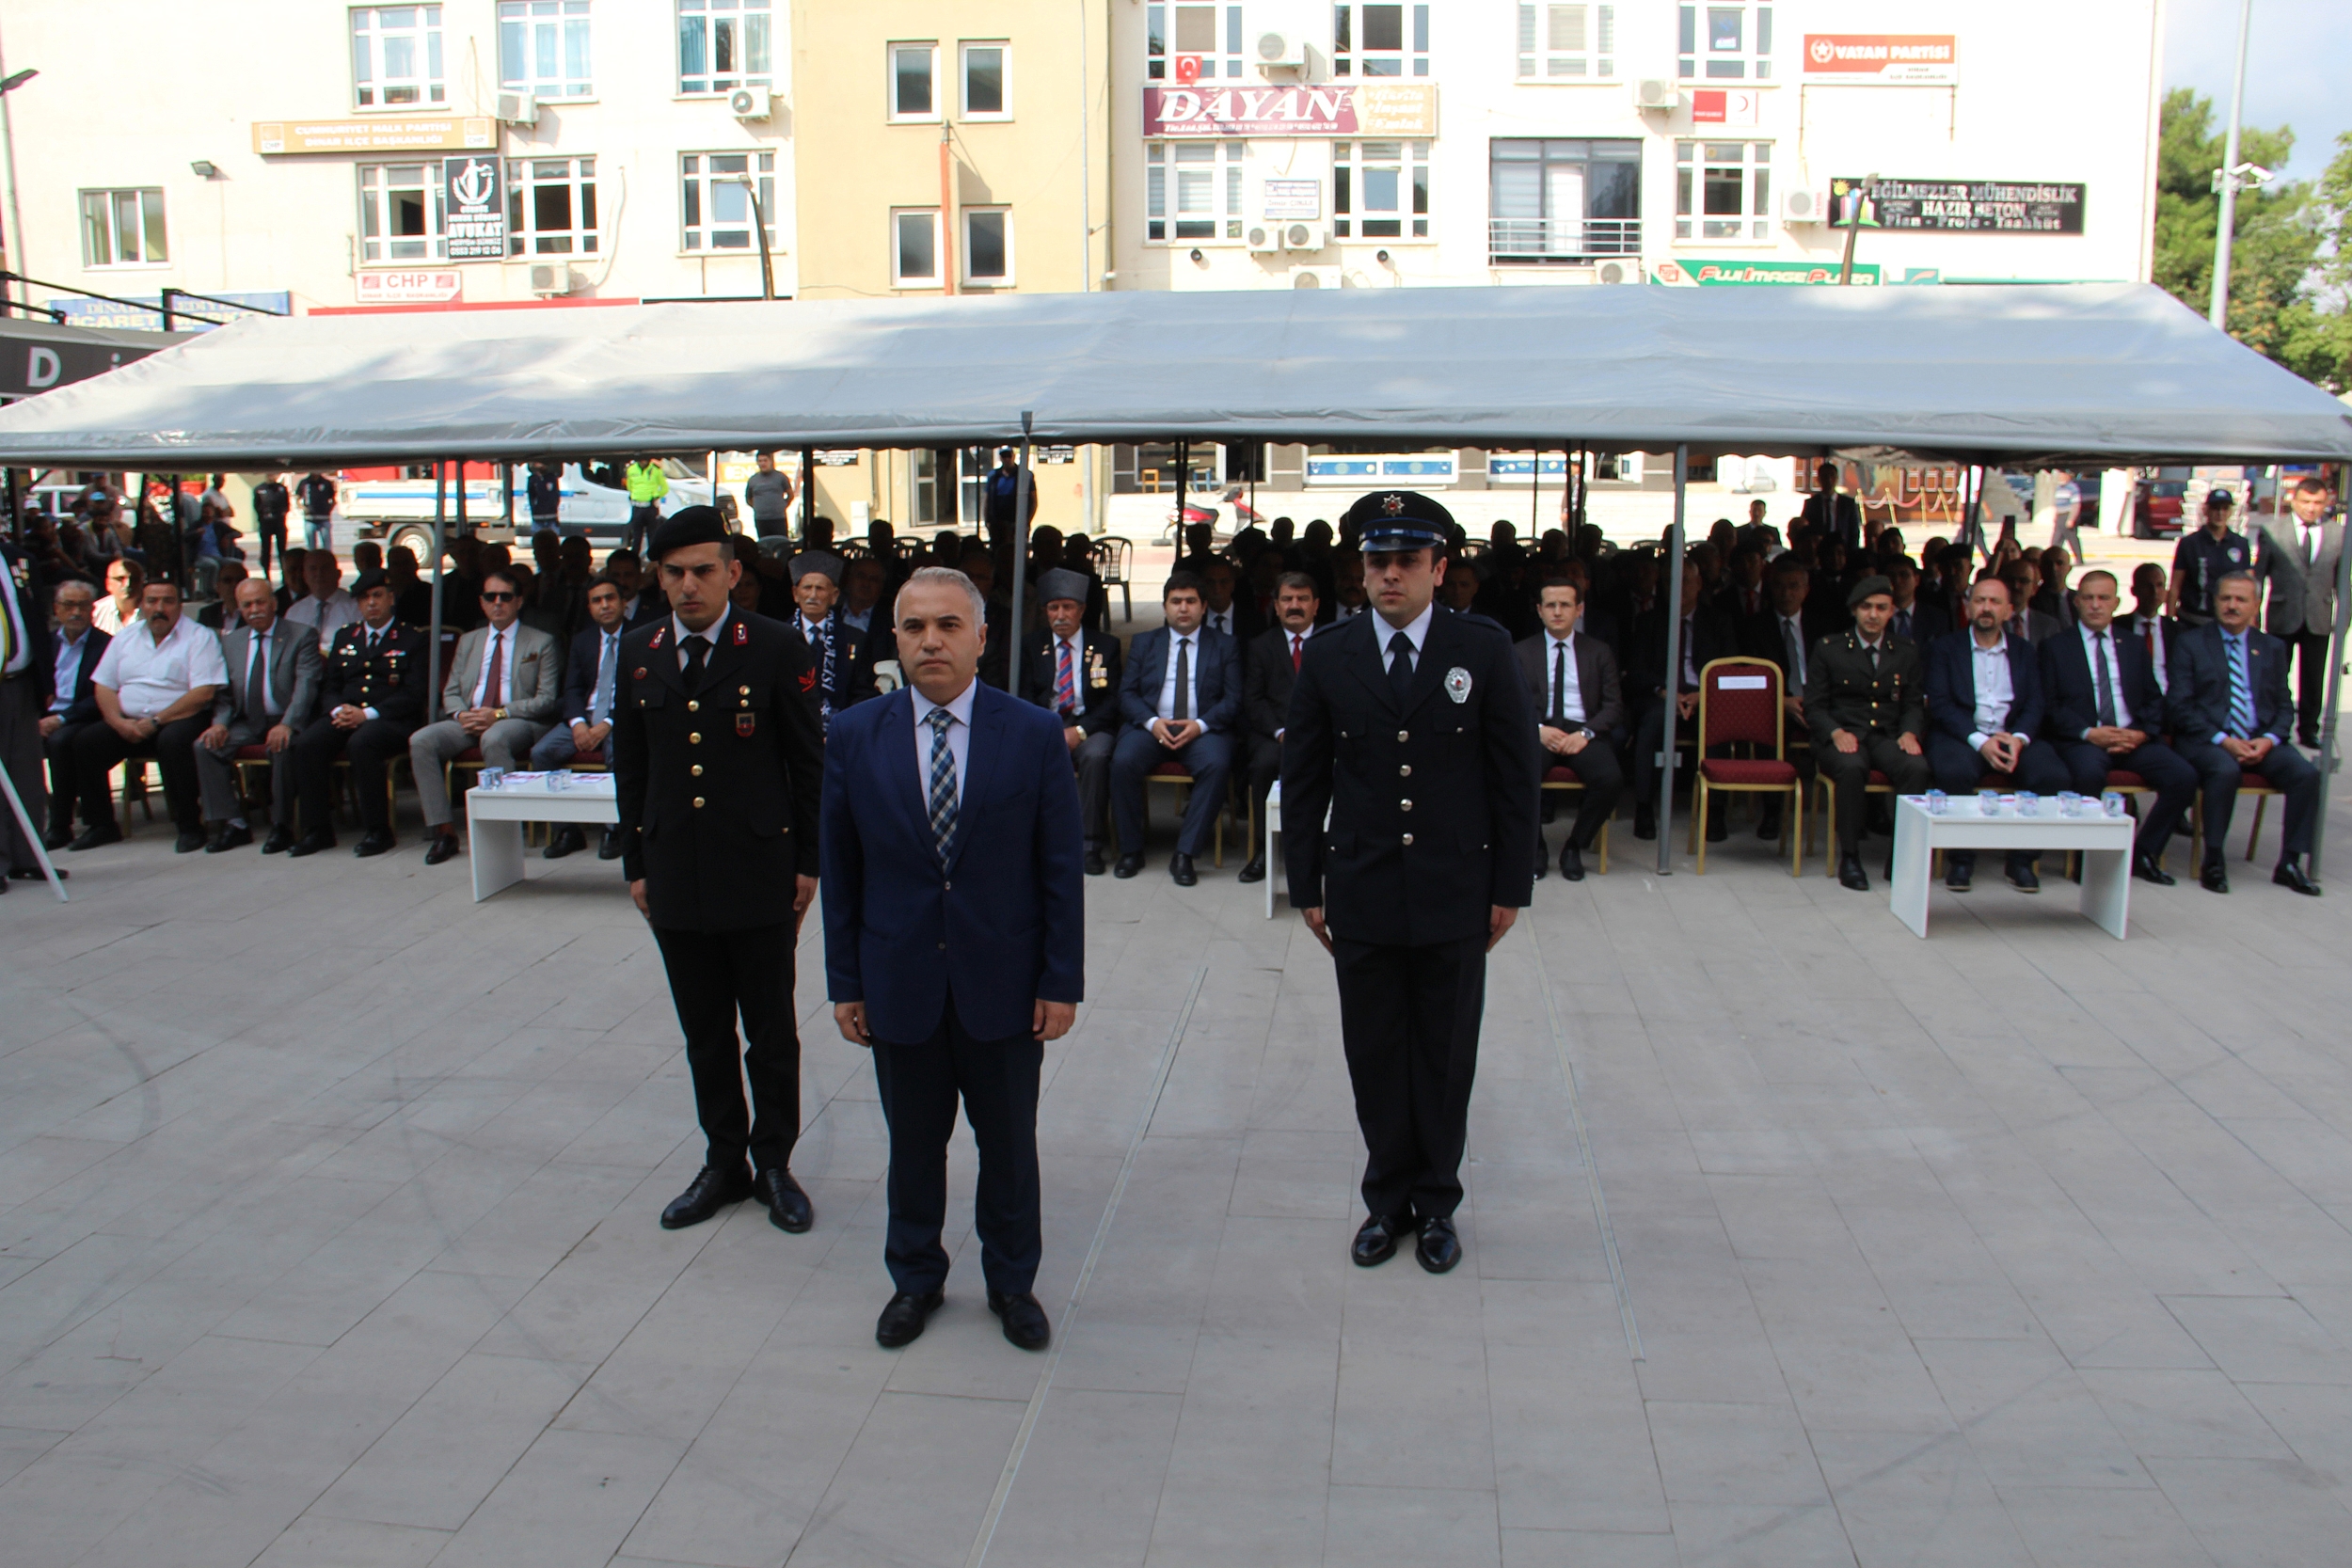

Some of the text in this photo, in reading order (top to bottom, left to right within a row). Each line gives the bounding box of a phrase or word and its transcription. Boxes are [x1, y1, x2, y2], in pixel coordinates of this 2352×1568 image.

[1835, 45, 1887, 59] VATAN
[1155, 89, 1348, 122] DAYAN
[294, 121, 452, 135] CUMHURİYET HALK PARTİSİ
[1969, 182, 2077, 203] MÜHENDİSLİK
[1921, 200, 1974, 217] HAZIR
[1975, 202, 2028, 218] BETON
[447, 221, 503, 238] AVUKAT
[387, 274, 428, 288] CHP
[1807, 268, 1876, 285] PLZA
